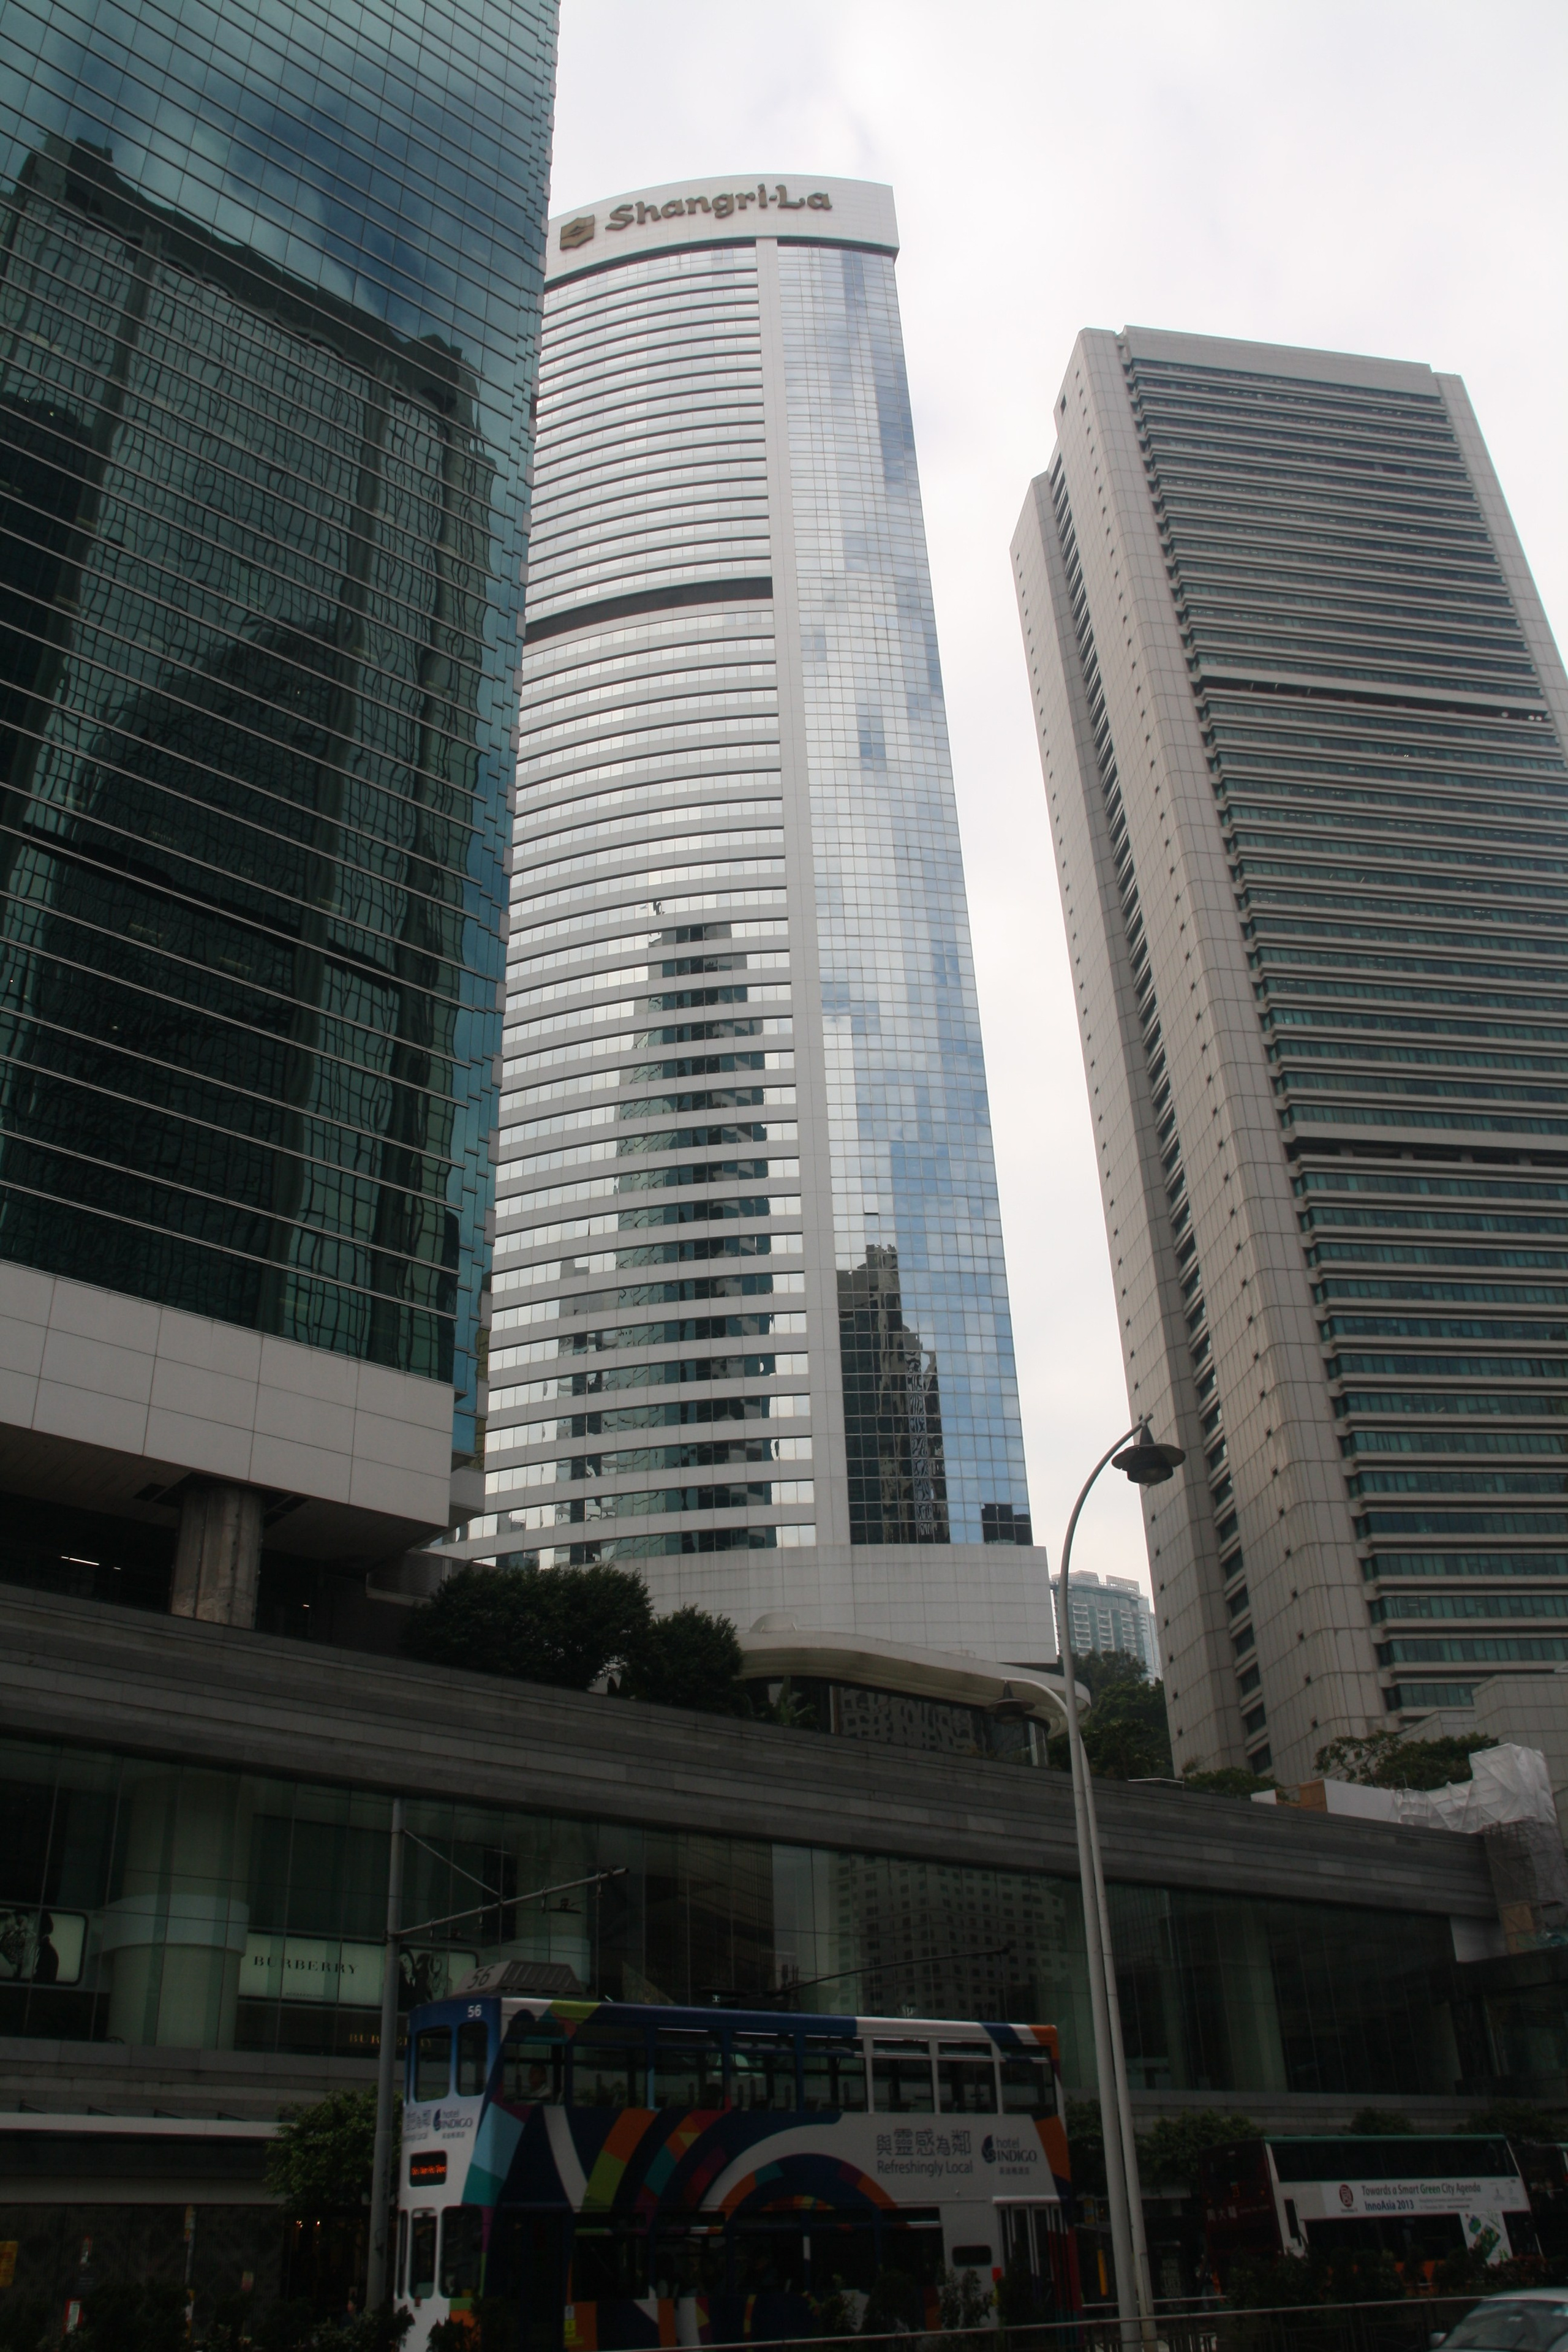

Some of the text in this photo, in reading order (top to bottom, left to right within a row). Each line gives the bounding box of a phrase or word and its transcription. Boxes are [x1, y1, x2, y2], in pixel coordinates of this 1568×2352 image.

[605, 184, 832, 230] Shangri-La
[254, 1956, 359, 1974] BURBERRY
[467, 1965, 495, 1989] 56
[467, 2004, 482, 2018] 56
[876, 2128, 972, 2157] 與靈感為鄰
[996, 2136, 1019, 2148] hotel
[997, 2150, 1036, 2163] INDIGO
[877, 2160, 973, 2177] Refreshingly Local
[1362, 2184, 1391, 2196] Towards
[1398, 2184, 1419, 2195] Smart
[1420, 2183, 1441, 2194] Green
[1442, 2183, 1455, 2195] City
[1456, 2182, 1481, 2195] Agenda
[1398, 2199, 1414, 2210] 2013
